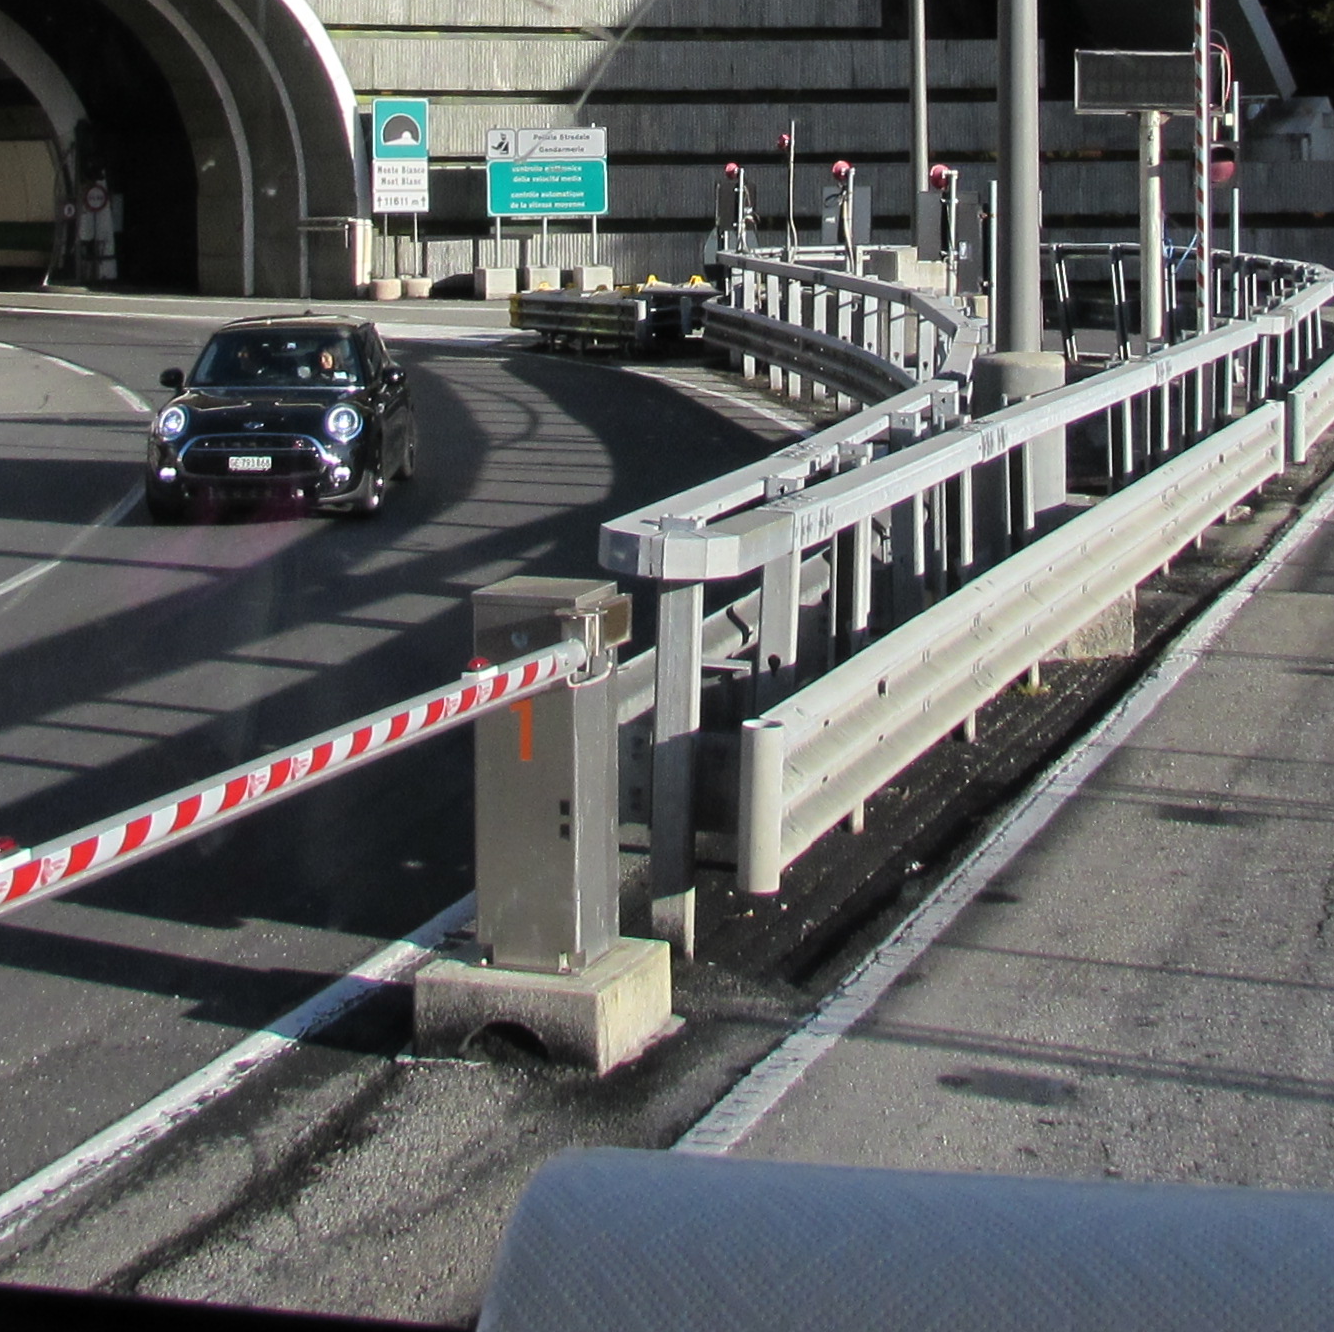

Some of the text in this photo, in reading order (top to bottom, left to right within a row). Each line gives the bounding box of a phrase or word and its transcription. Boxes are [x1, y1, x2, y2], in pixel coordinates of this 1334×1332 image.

[539, 145, 585, 153] Gendarmerie
[377, 164, 425, 174] Monte Bianco
[380, 176, 421, 186] Mont Blanc
[384, 196, 408, 206] 11611
[510, 201, 519, 209] de
[520, 201, 528, 209] la
[509, 698, 533, 761] 1
